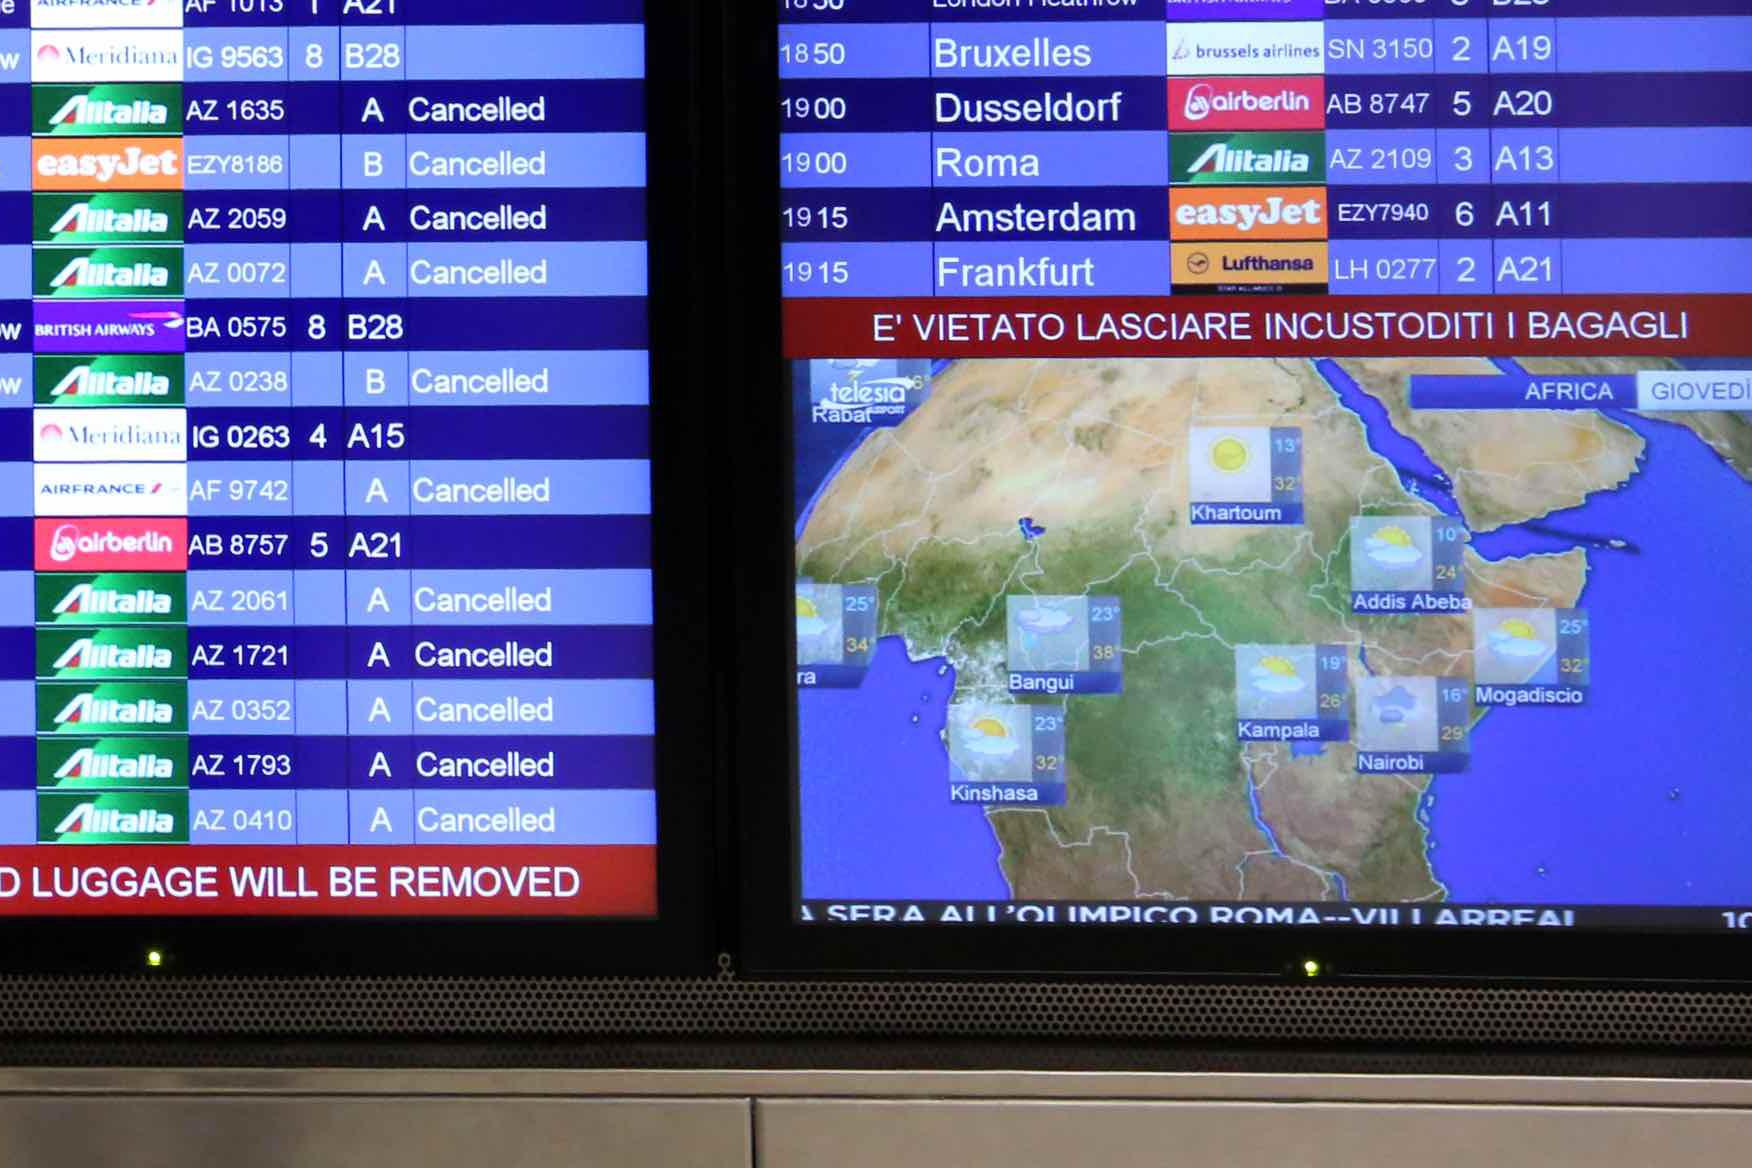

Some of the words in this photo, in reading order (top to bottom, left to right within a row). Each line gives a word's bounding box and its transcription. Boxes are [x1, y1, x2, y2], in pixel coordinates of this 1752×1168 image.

[936, 37, 1092, 68] Bruxelles
[1196, 44, 1260, 60] brussels
[1263, 43, 1320, 59] airlines
[937, 91, 1123, 123] Dusseldorf
[1211, 89, 1309, 111] airberlin
[1338, 203, 1429, 222] EZY7940
[873, 313, 902, 342] E'
[912, 313, 1065, 341] VIETATO
[1077, 312, 1252, 341] LASCIARE
[1265, 311, 1493, 340] INCUSTODITI
[1507, 311, 1514, 339] I
[1528, 311, 1687, 339] BAGAGLI
[1524, 382, 1614, 401] AFRICA
[812, 406, 872, 424] Rabat
[192, 425, 220, 449] IG
[226, 425, 291, 449] 0263
[1191, 505, 1283, 521] Khartoum
[1353, 593, 1406, 610] Addis
[1411, 593, 1473, 610] Abeba
[1009, 674, 1075, 693] Bangui
[1475, 687, 1583, 706] Mogadiscio
[1238, 723, 1320, 741] Kampala
[191, 754, 226, 776] AZ
[233, 754, 292, 776] 1793
[416, 751, 554, 778] Cancelled
[1358, 753, 1424, 771] Nairobi
[951, 785, 1039, 802] Kinshasa
[32, 866, 219, 898] LUGGAGE
[228, 866, 319, 898] WILL
[329, 866, 378, 898] BE
[389, 865, 580, 898] REMOVED
